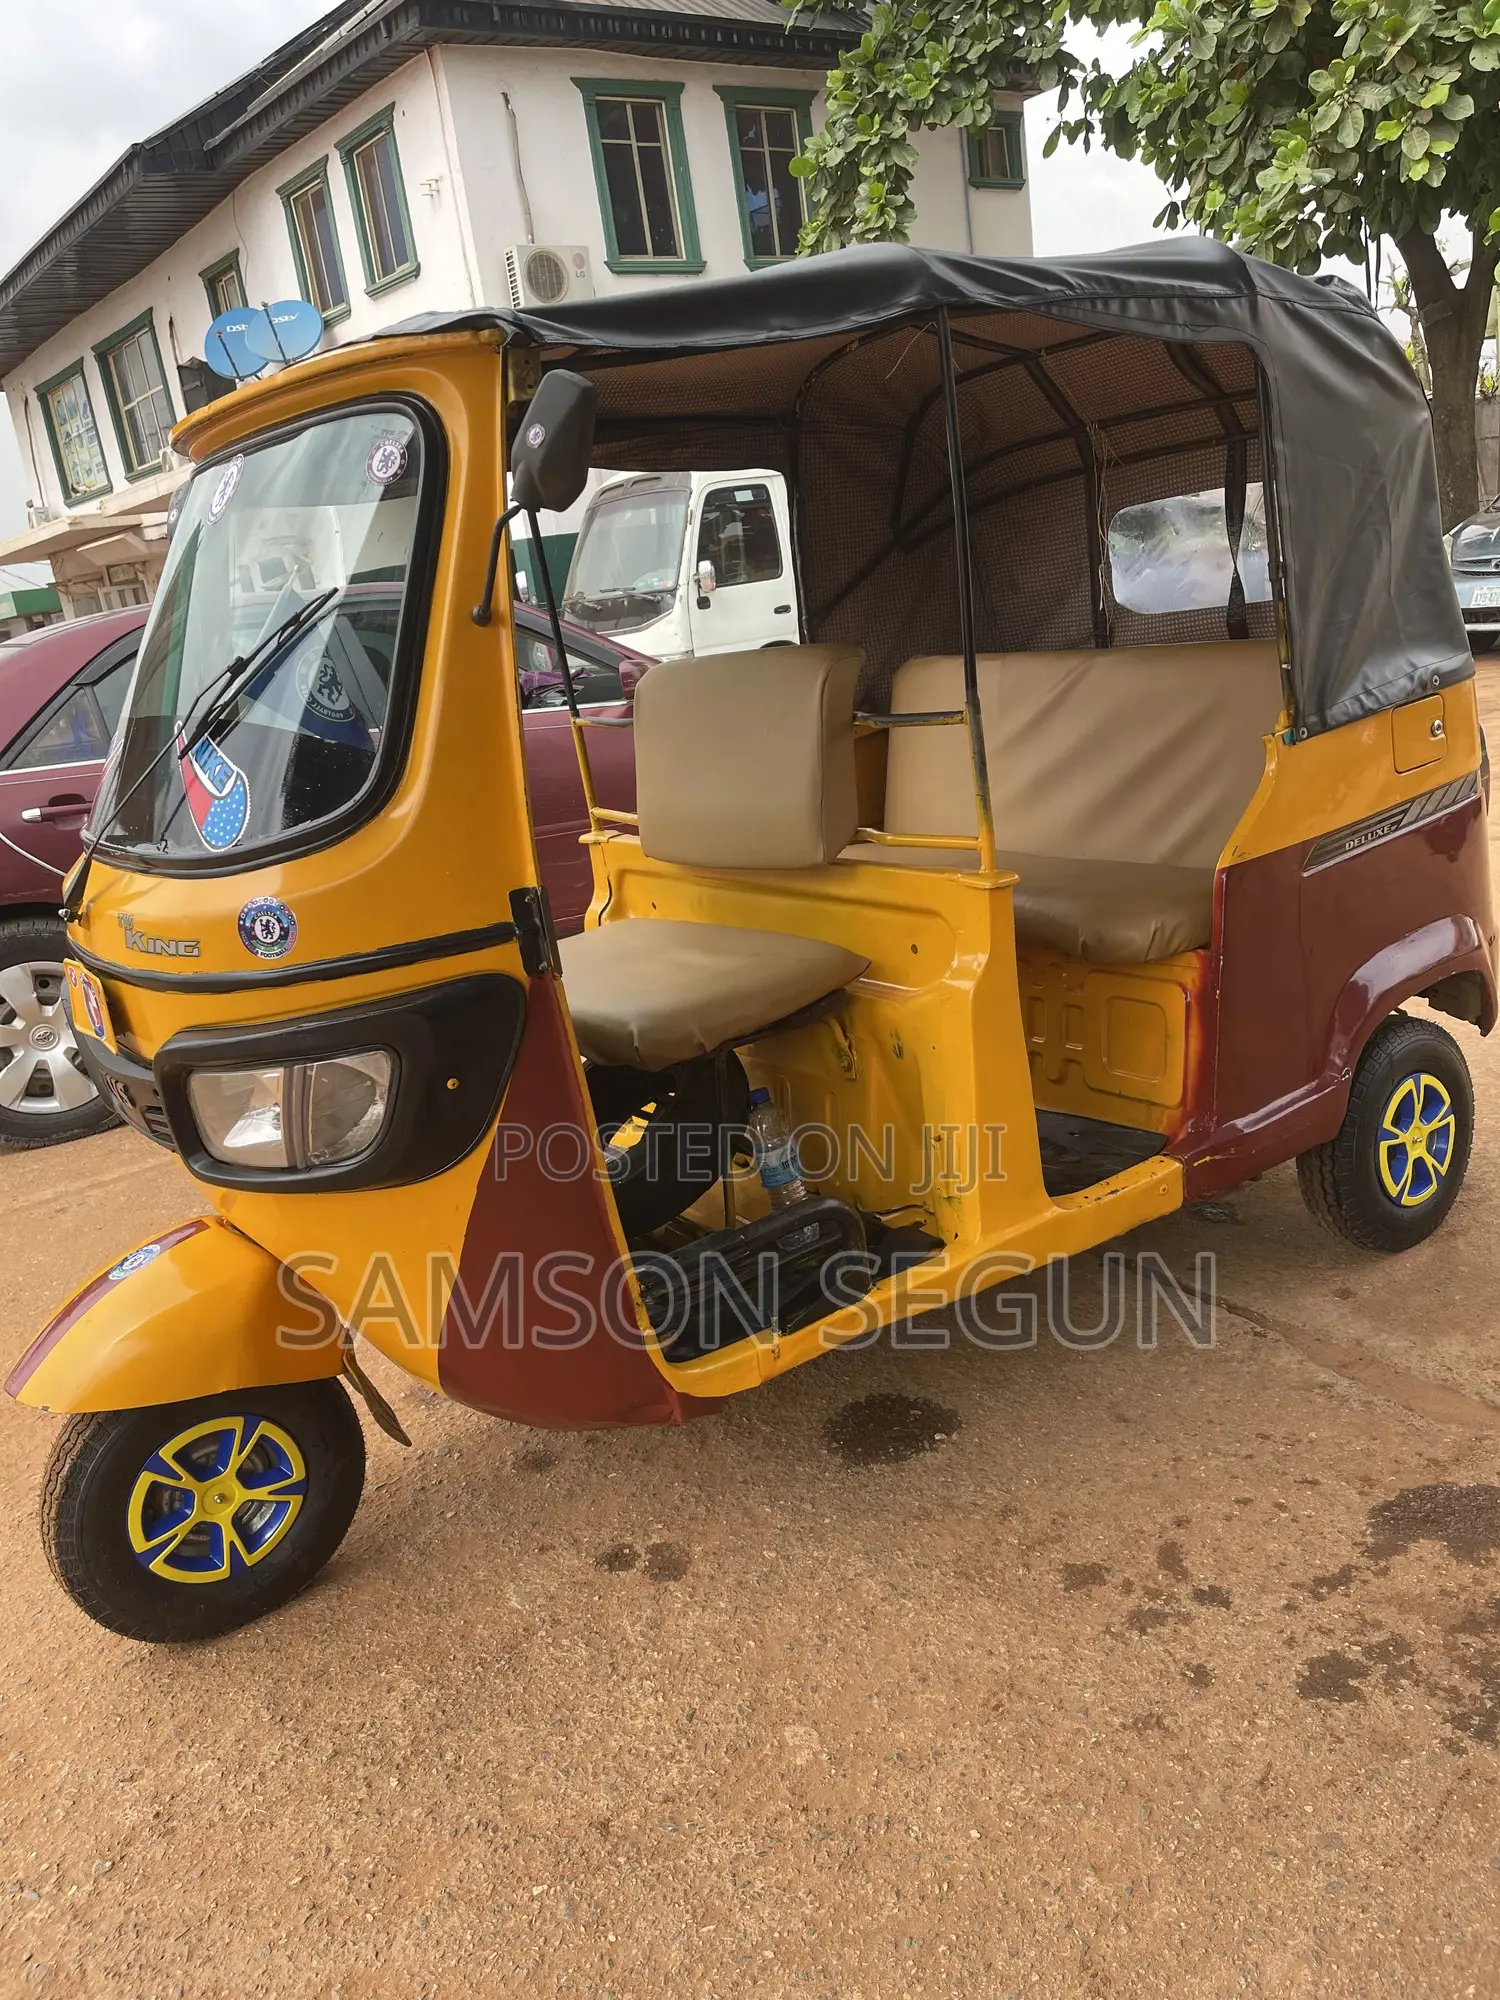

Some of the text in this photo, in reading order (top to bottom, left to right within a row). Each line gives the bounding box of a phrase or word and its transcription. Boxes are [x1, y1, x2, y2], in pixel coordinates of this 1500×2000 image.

[574, 270, 586, 279] LG
[380, 439, 405, 454] CHELSEA
[1345, 825, 1391, 850] DELUXE
[254, 910, 278, 920] CHELSEA
